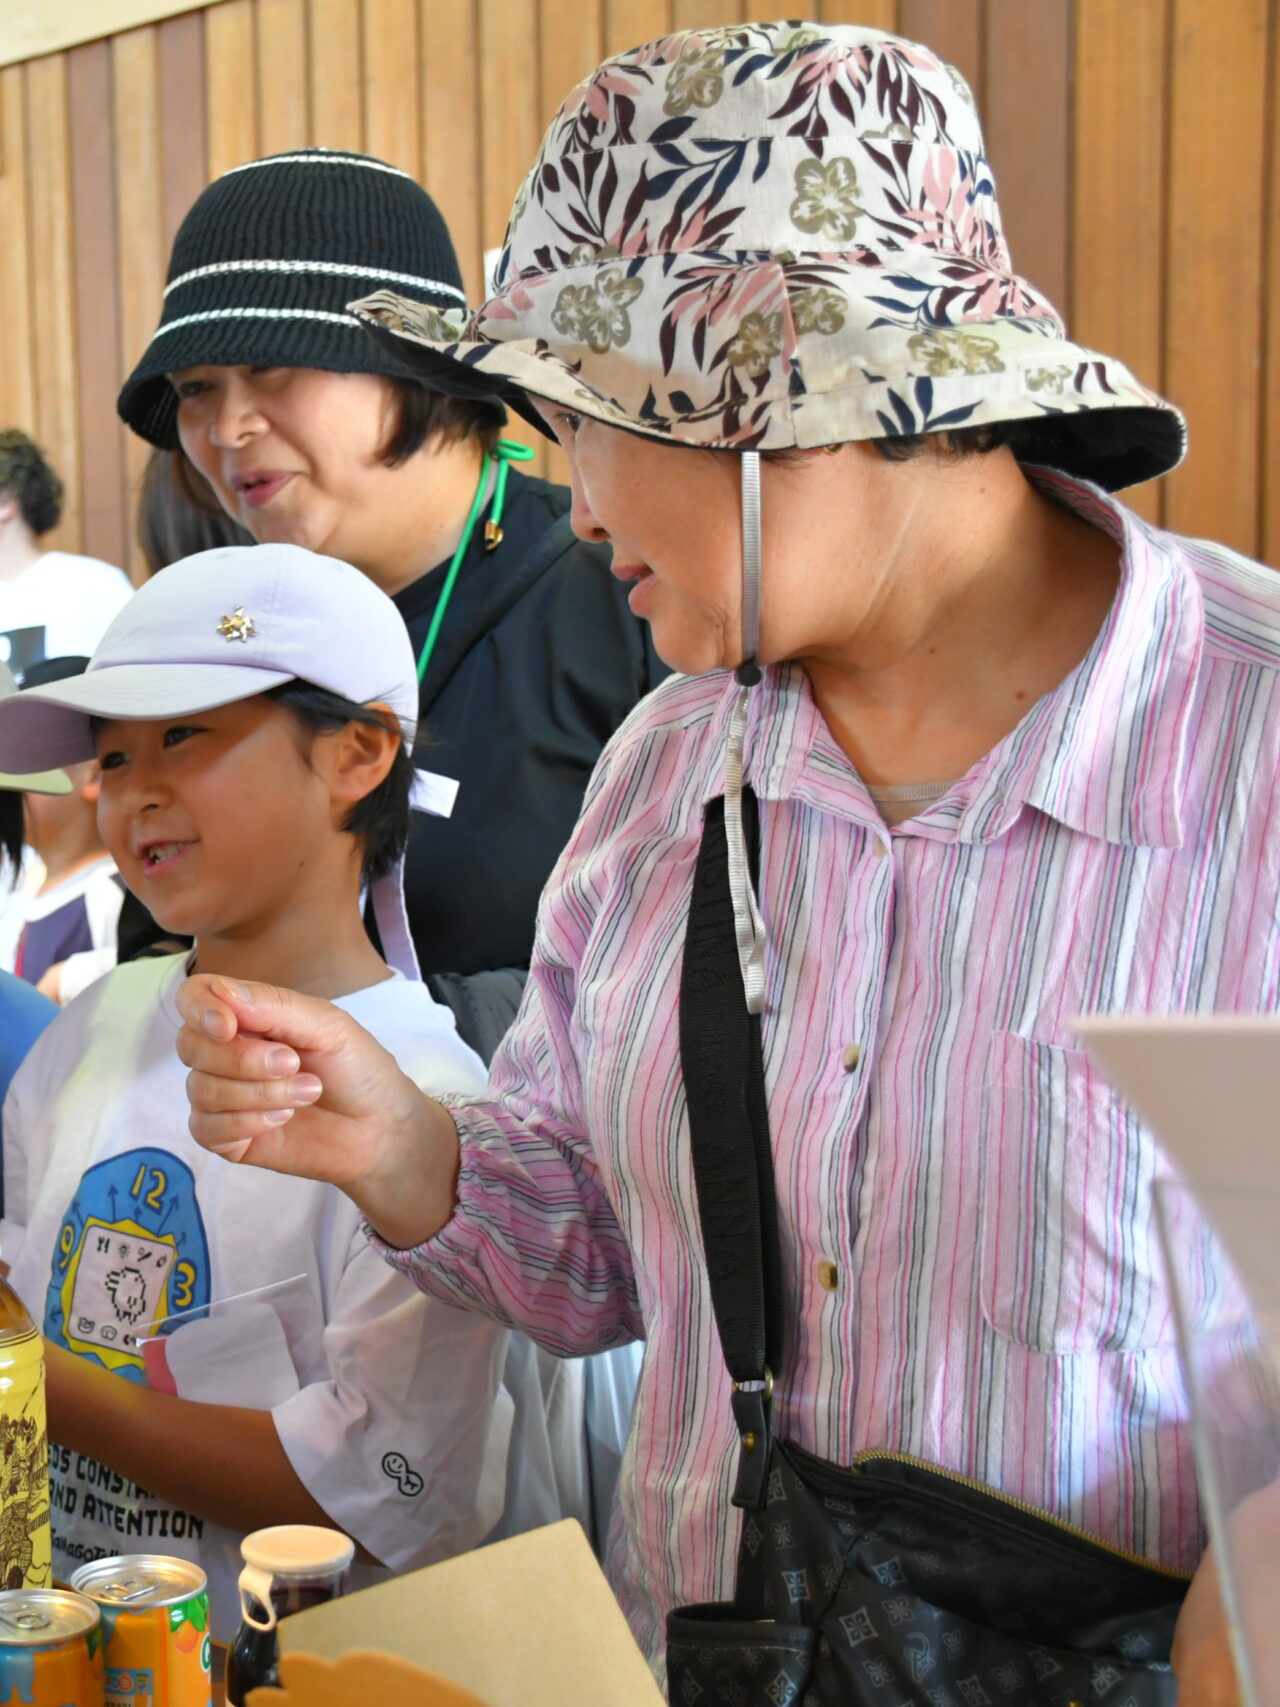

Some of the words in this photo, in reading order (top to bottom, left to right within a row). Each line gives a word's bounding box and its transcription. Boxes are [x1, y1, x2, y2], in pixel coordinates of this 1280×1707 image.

[130, 1162, 168, 1215] 12
[58, 1223, 76, 1273] 9
[172, 1260, 198, 1308] 3
[82, 1492, 204, 1539] ATTENTION
